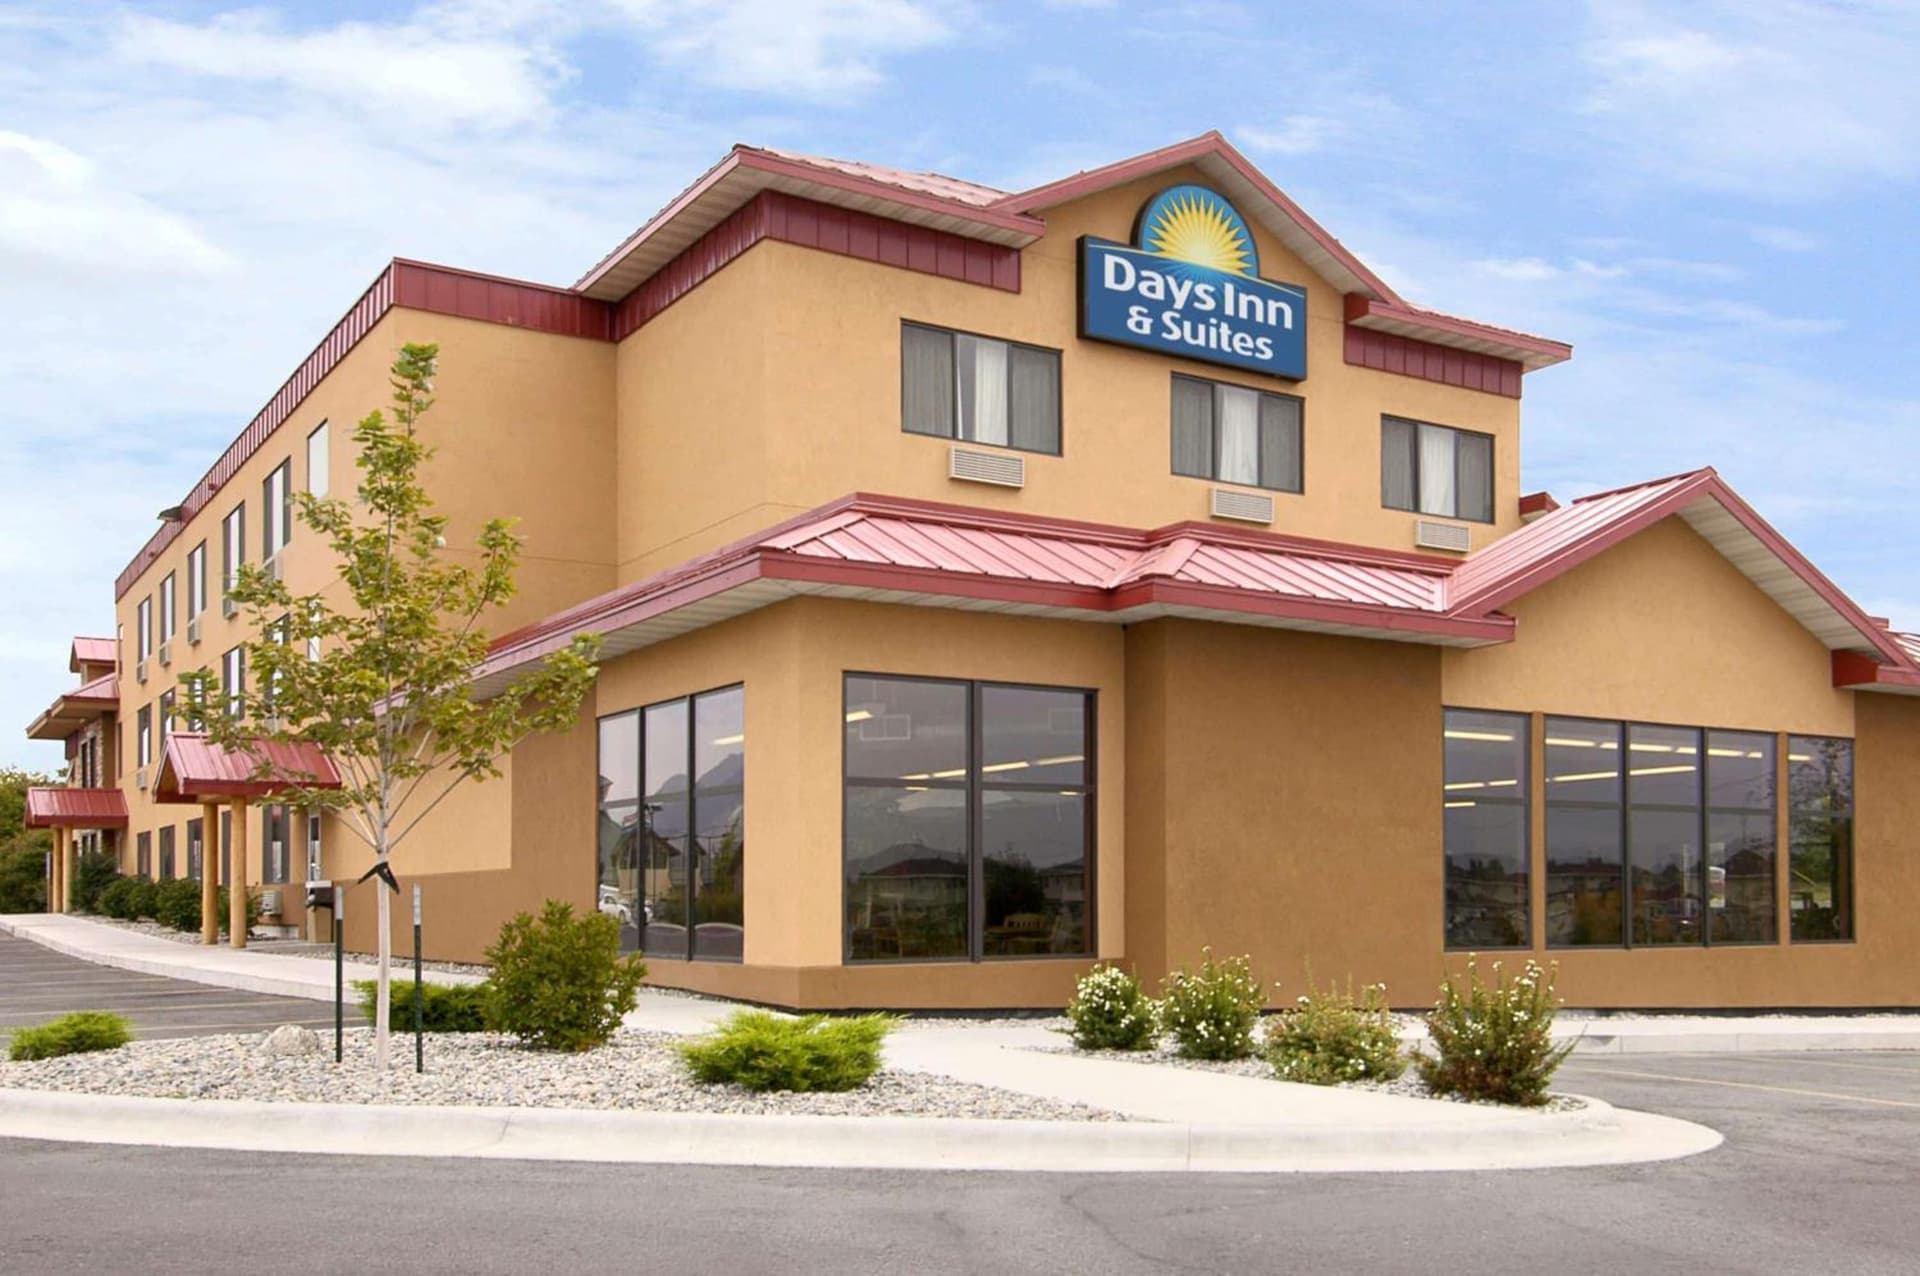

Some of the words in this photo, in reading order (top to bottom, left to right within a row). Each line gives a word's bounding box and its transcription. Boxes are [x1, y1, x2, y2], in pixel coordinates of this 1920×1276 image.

[1104, 254, 1216, 311] Days
[1224, 283, 1293, 329] Inn
[1127, 305, 1153, 335] &
[1161, 311, 1274, 360] Suites
